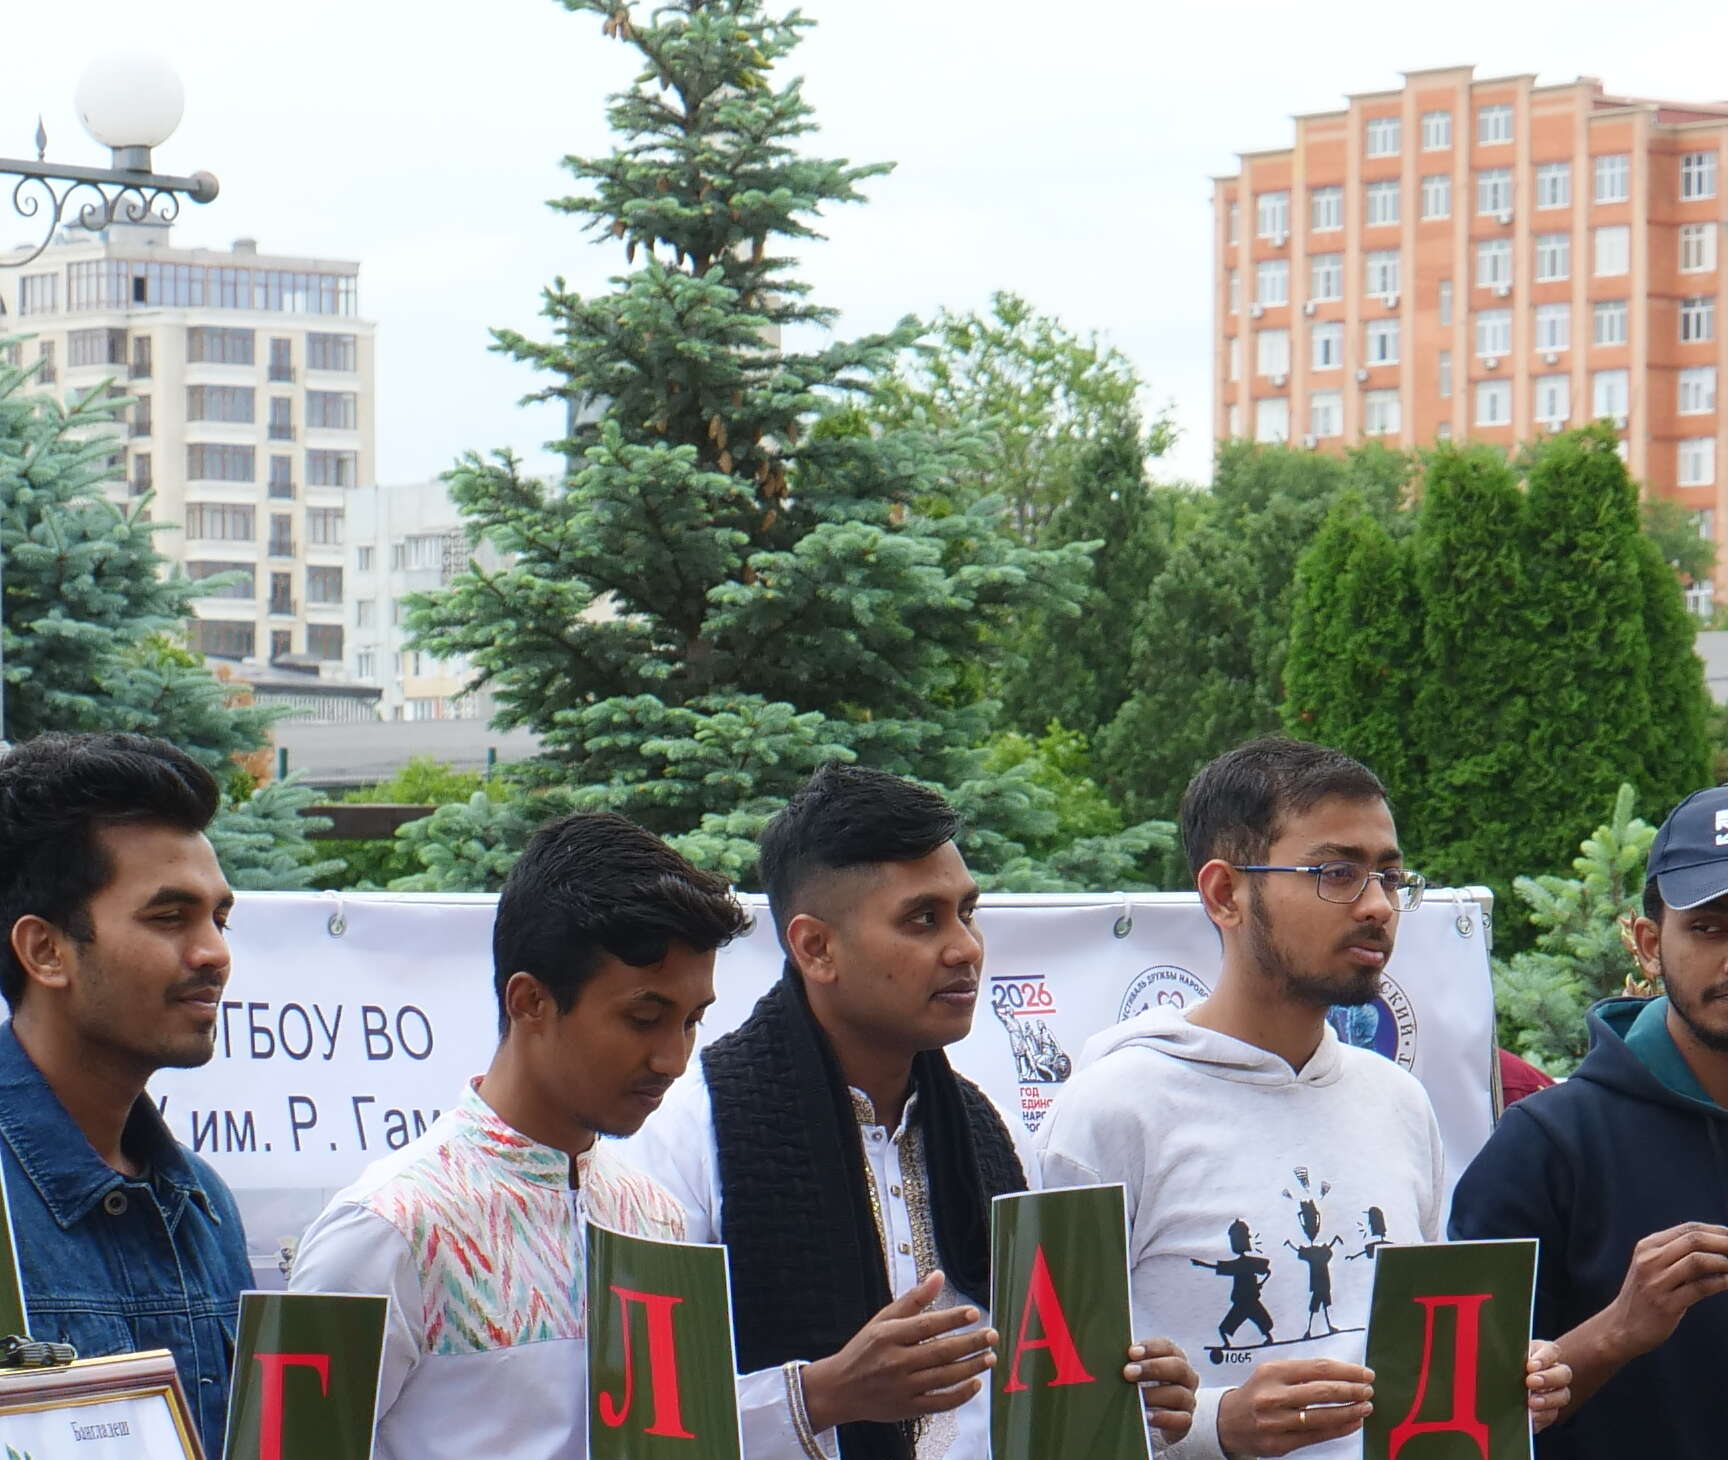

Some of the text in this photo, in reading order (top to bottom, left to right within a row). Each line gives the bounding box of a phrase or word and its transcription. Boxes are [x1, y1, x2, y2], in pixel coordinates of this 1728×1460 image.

[992, 982, 1053, 1008] 2026
[213, 1000, 434, 1060] ГБОУ ВО
[1020, 1087, 1039, 1098] ГОД
[191, 1109, 272, 1152] им.
[1003, 1244, 1096, 1393] А
[598, 1285, 696, 1439] Л
